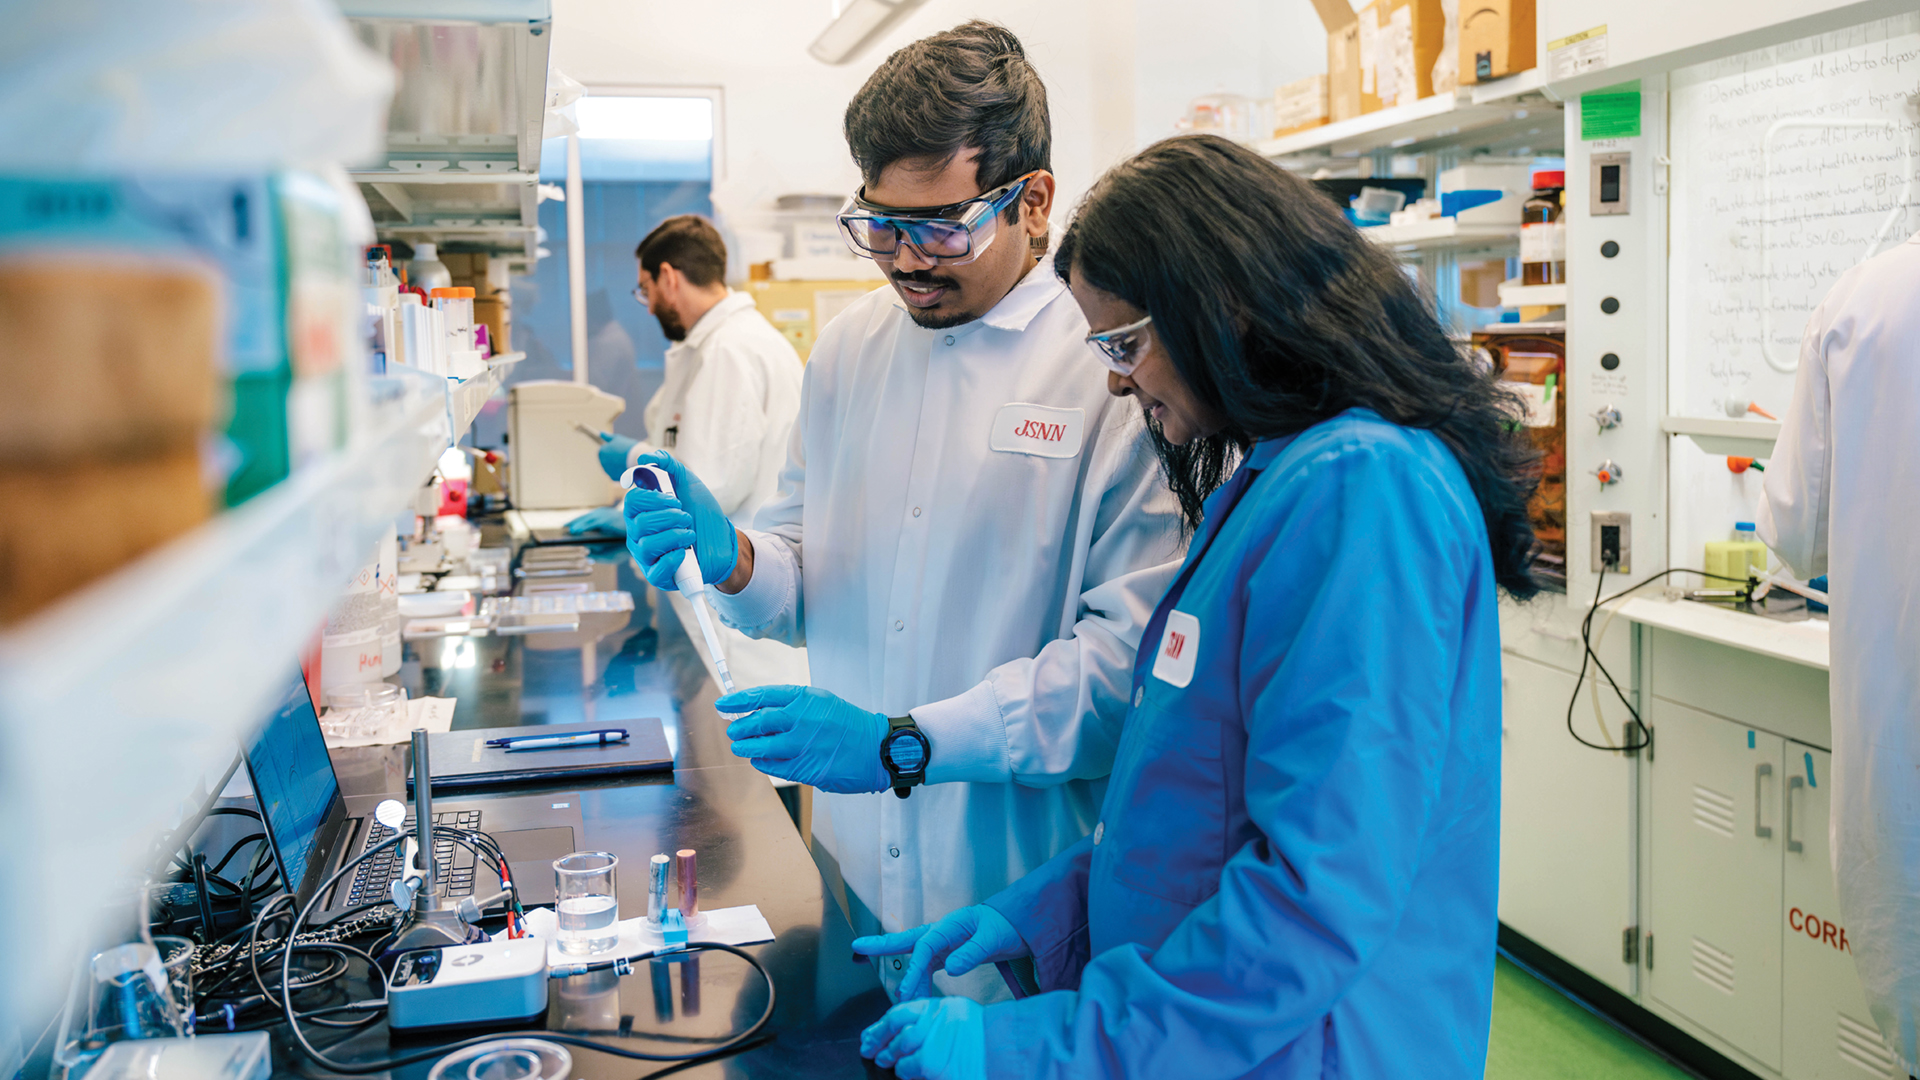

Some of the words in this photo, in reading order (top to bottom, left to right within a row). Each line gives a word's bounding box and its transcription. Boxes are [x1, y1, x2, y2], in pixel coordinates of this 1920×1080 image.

[1709, 84, 1729, 104] Do
[1729, 74, 1749, 98] not
[1751, 78, 1773, 93] use
[1775, 69, 1806, 87] bare
[1829, 54, 1860, 76] stub
[1860, 49, 1878, 70] to
[1868, 89, 1891, 111] tape
[1014, 419, 1067, 442] JSNN
